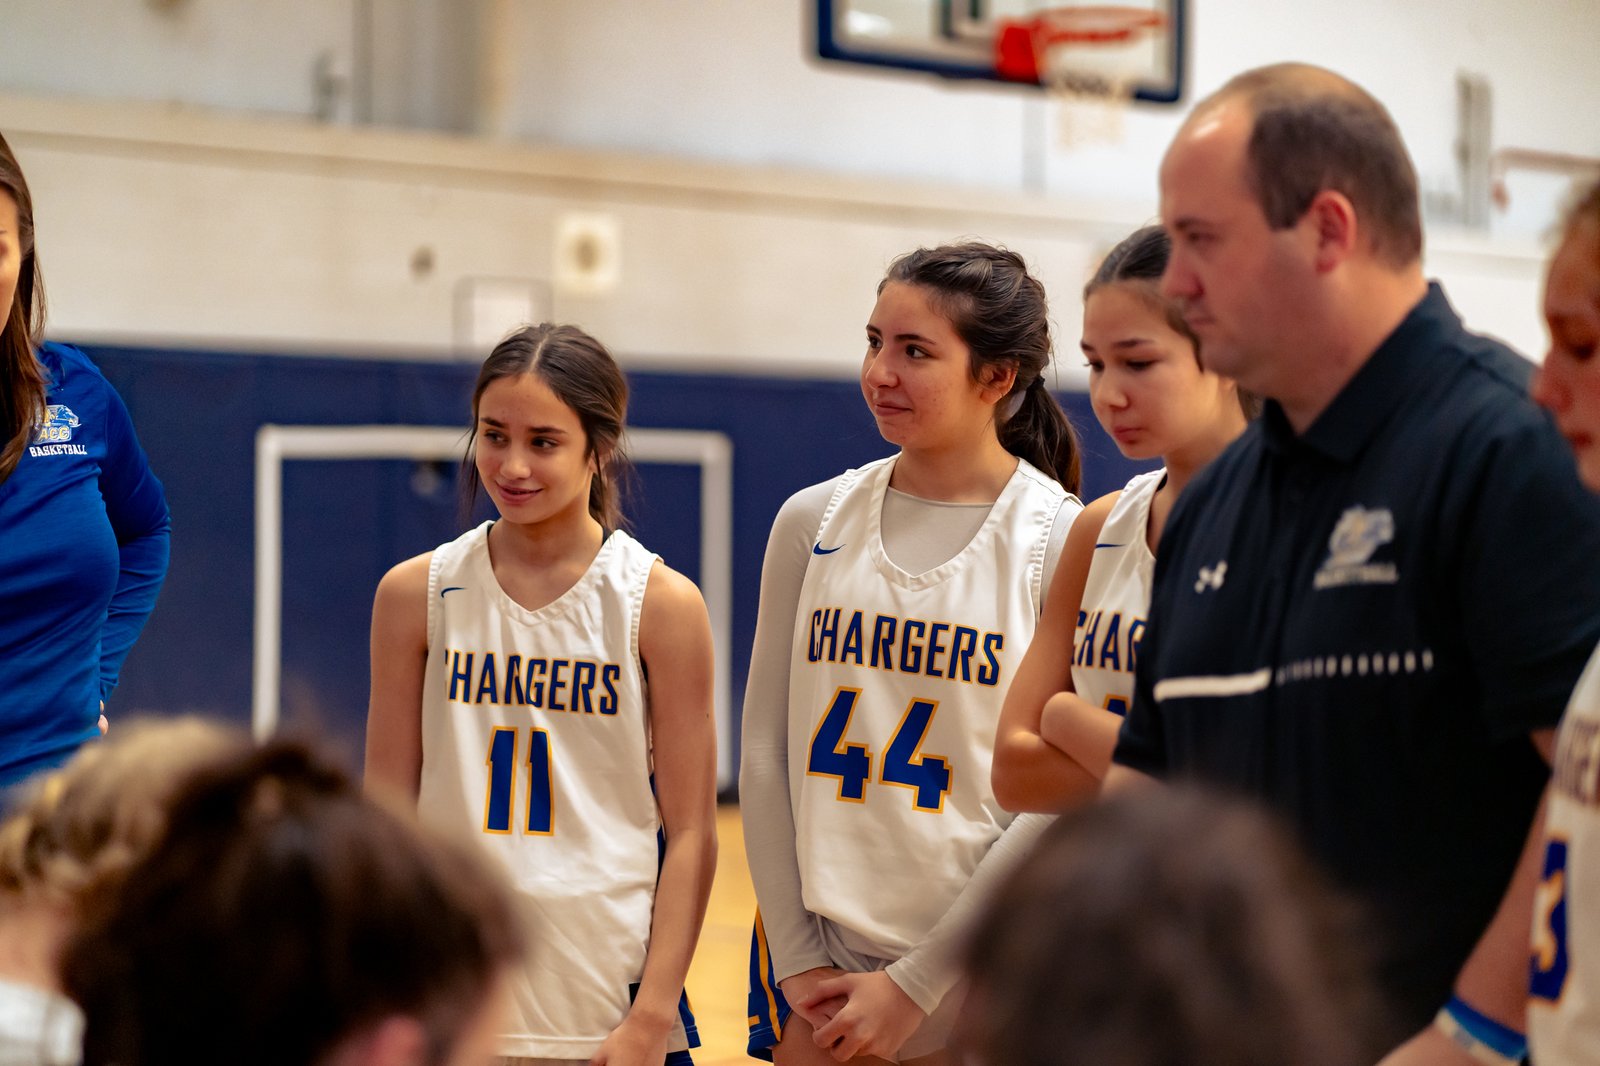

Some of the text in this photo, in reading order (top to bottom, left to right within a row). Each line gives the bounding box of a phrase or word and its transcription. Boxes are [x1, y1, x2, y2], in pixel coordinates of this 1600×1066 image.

[29, 444, 87, 457] BASKETBALL
[445, 649, 620, 716] HARGERS
[808, 607, 1004, 687] CHARGERS
[483, 725, 555, 836] 11
[806, 685, 953, 814] 44
